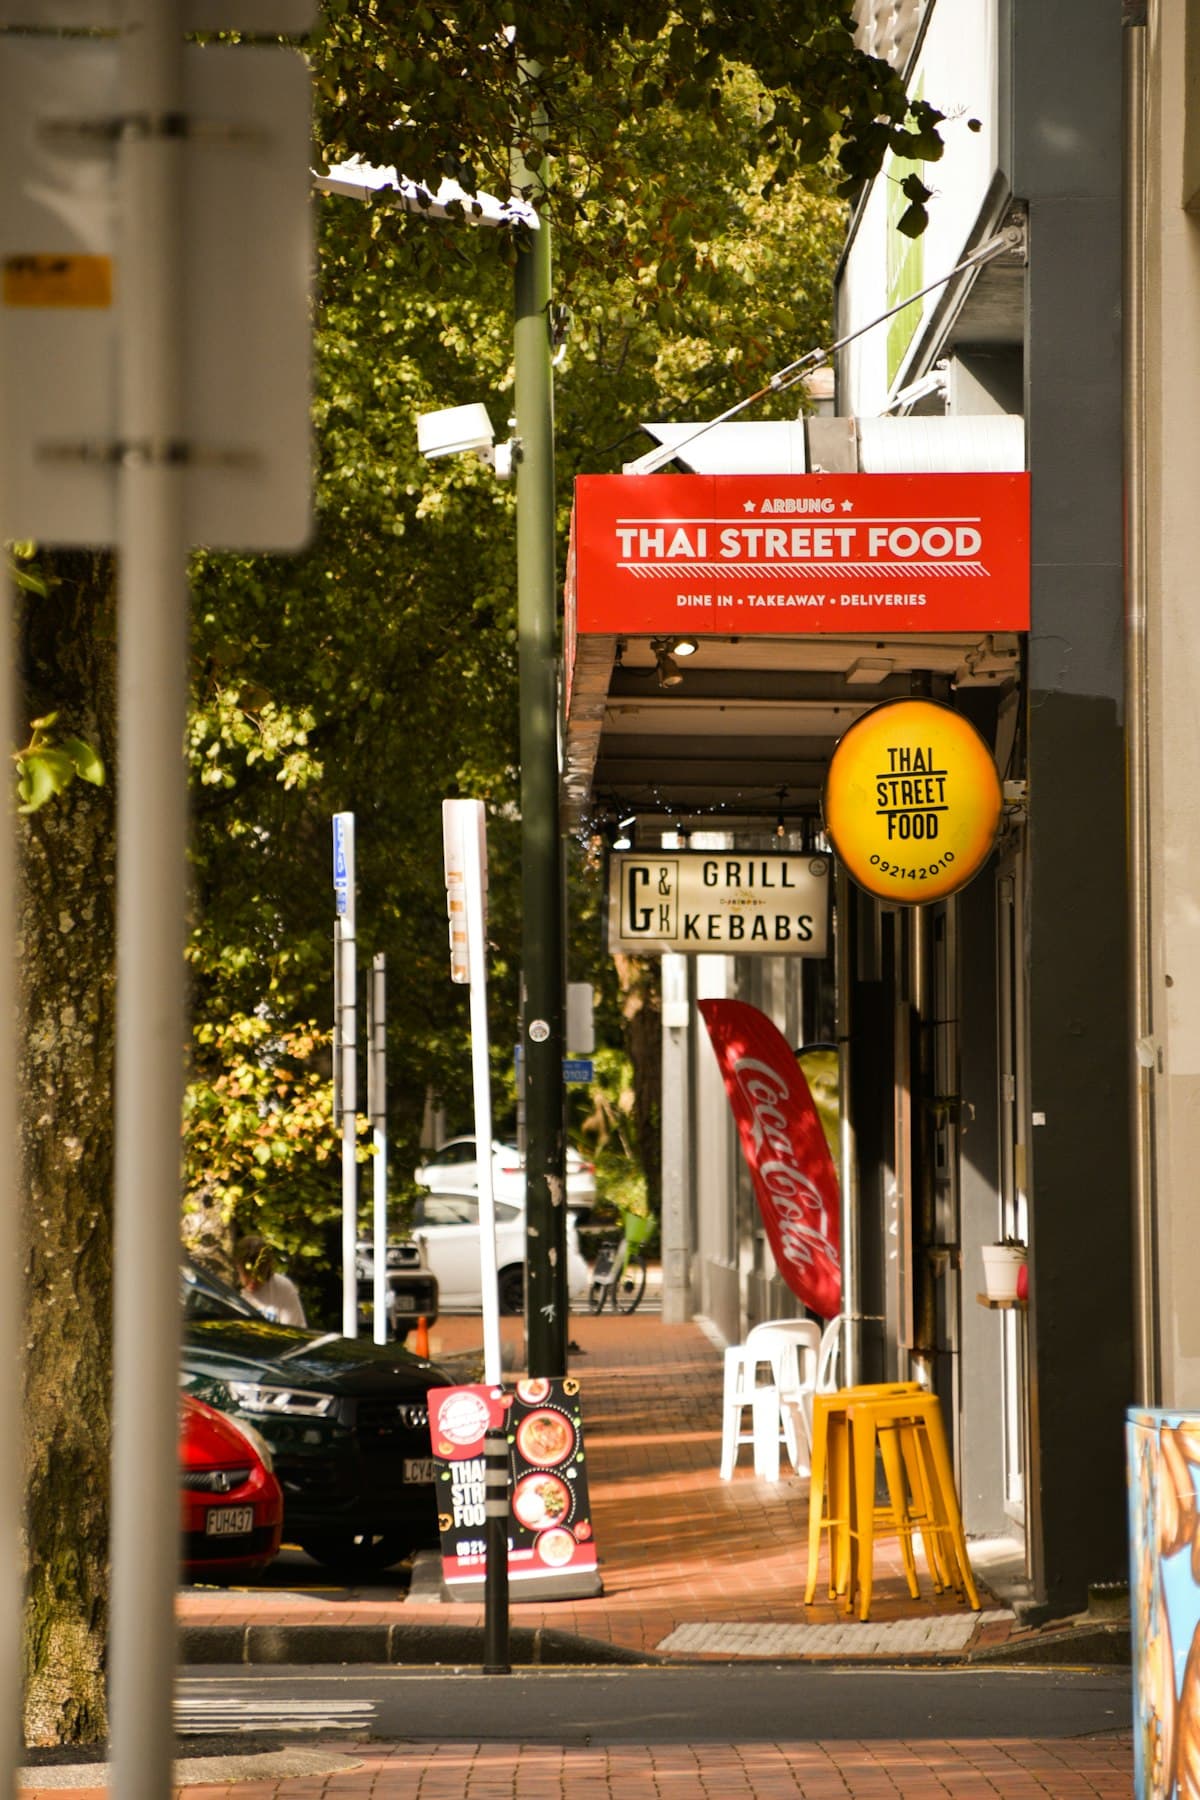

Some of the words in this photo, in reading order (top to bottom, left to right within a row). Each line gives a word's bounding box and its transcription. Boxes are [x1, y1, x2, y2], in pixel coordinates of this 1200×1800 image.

[760, 497, 836, 514] ARBUNG
[615, 527, 707, 559] THAI
[719, 527, 857, 559] STREET
[868, 526, 982, 558] FOOD
[676, 594, 713, 607] DINE
[717, 594, 733, 607] IN
[747, 593, 826, 607] TAKEAWAY
[840, 593, 927, 607] DELIVERIES
[887, 747, 933, 772] THAI
[876, 777, 947, 807] STREET
[887, 813, 939, 840] FOOD
[703, 861, 796, 888] GRILL
[869, 851, 955, 880] 092142010
[684, 914, 813, 942] KEBABS
[207, 1510, 252, 1532] FUH437
[453, 1504, 487, 1528] FOO
